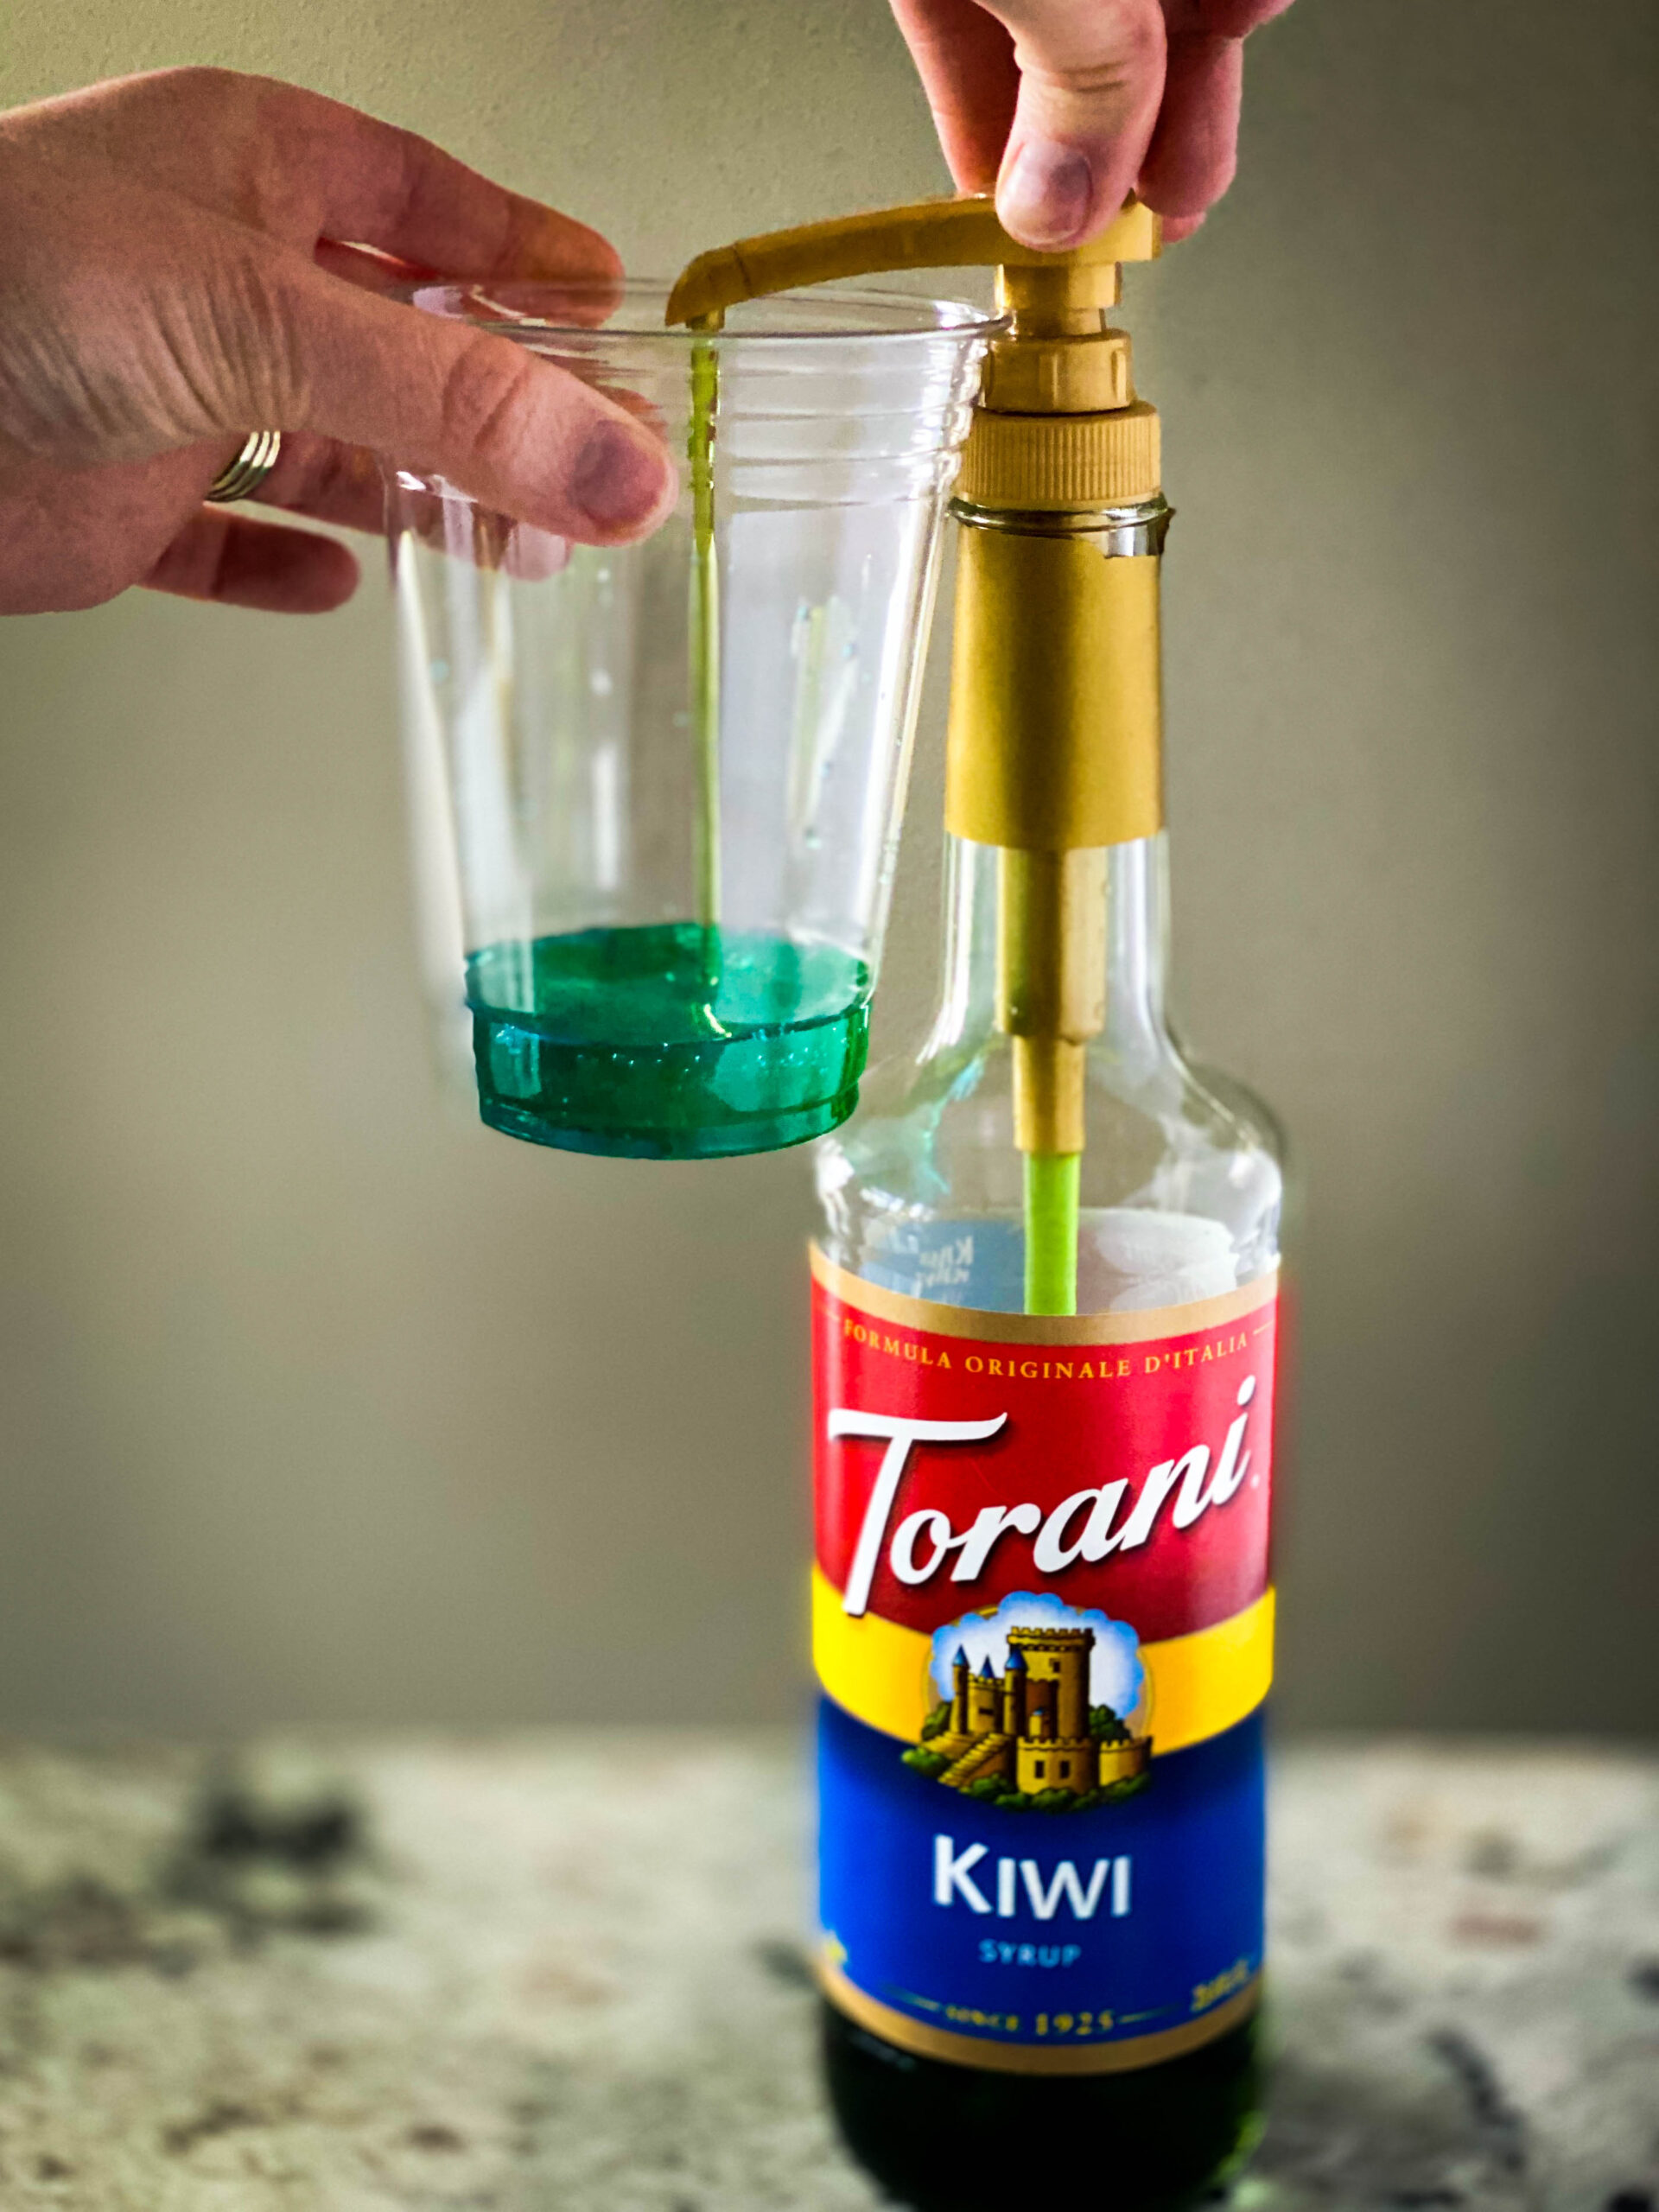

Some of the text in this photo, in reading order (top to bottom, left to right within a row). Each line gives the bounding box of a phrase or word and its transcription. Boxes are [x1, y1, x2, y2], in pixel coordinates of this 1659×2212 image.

[844, 1319, 1248, 1379] FORMULA ORIGINALE D'ITALIA
[827, 1375, 1256, 1616] Torani
[932, 1834, 1132, 1920] KIWI
[978, 1938, 1082, 1967] SYRUP
[1034, 2009, 1115, 2036] 1925
